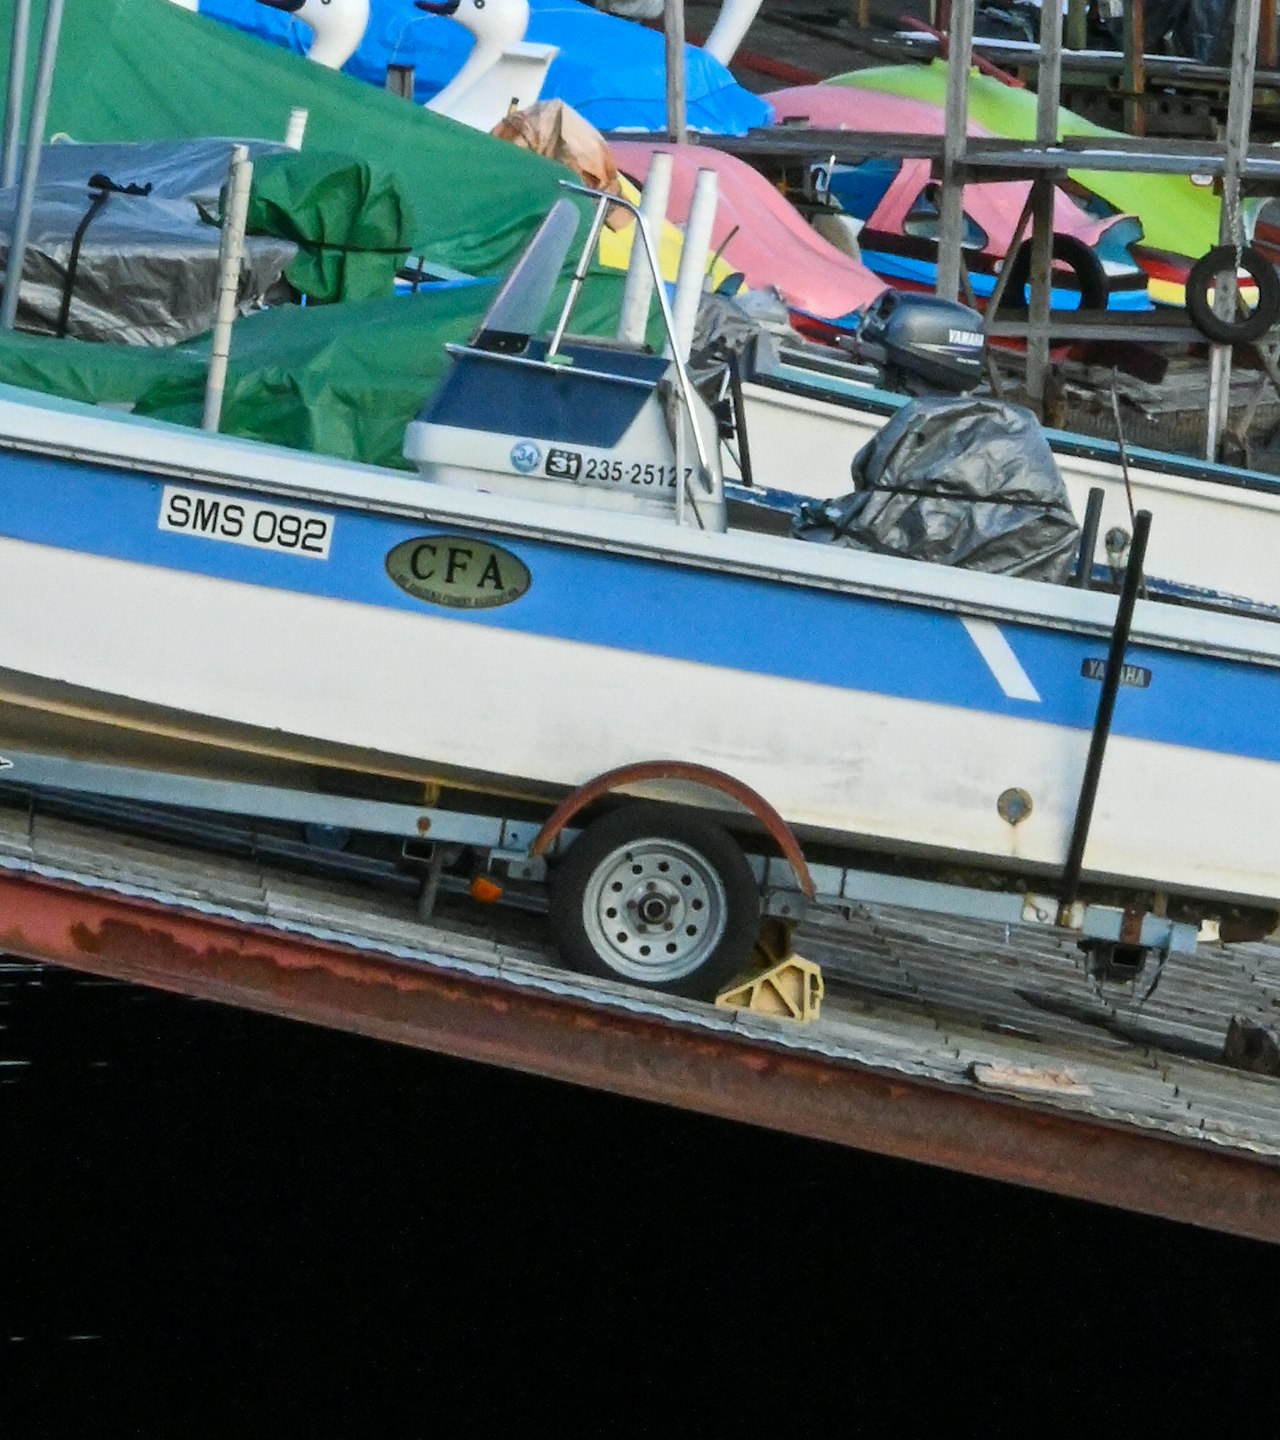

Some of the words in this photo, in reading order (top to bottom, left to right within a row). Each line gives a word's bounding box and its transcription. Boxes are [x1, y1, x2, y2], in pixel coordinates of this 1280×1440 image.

[549, 456, 578, 475] 31
[167, 494, 245, 538] SMS
[253, 509, 328, 553] 092
[410, 544, 505, 590] CFA
